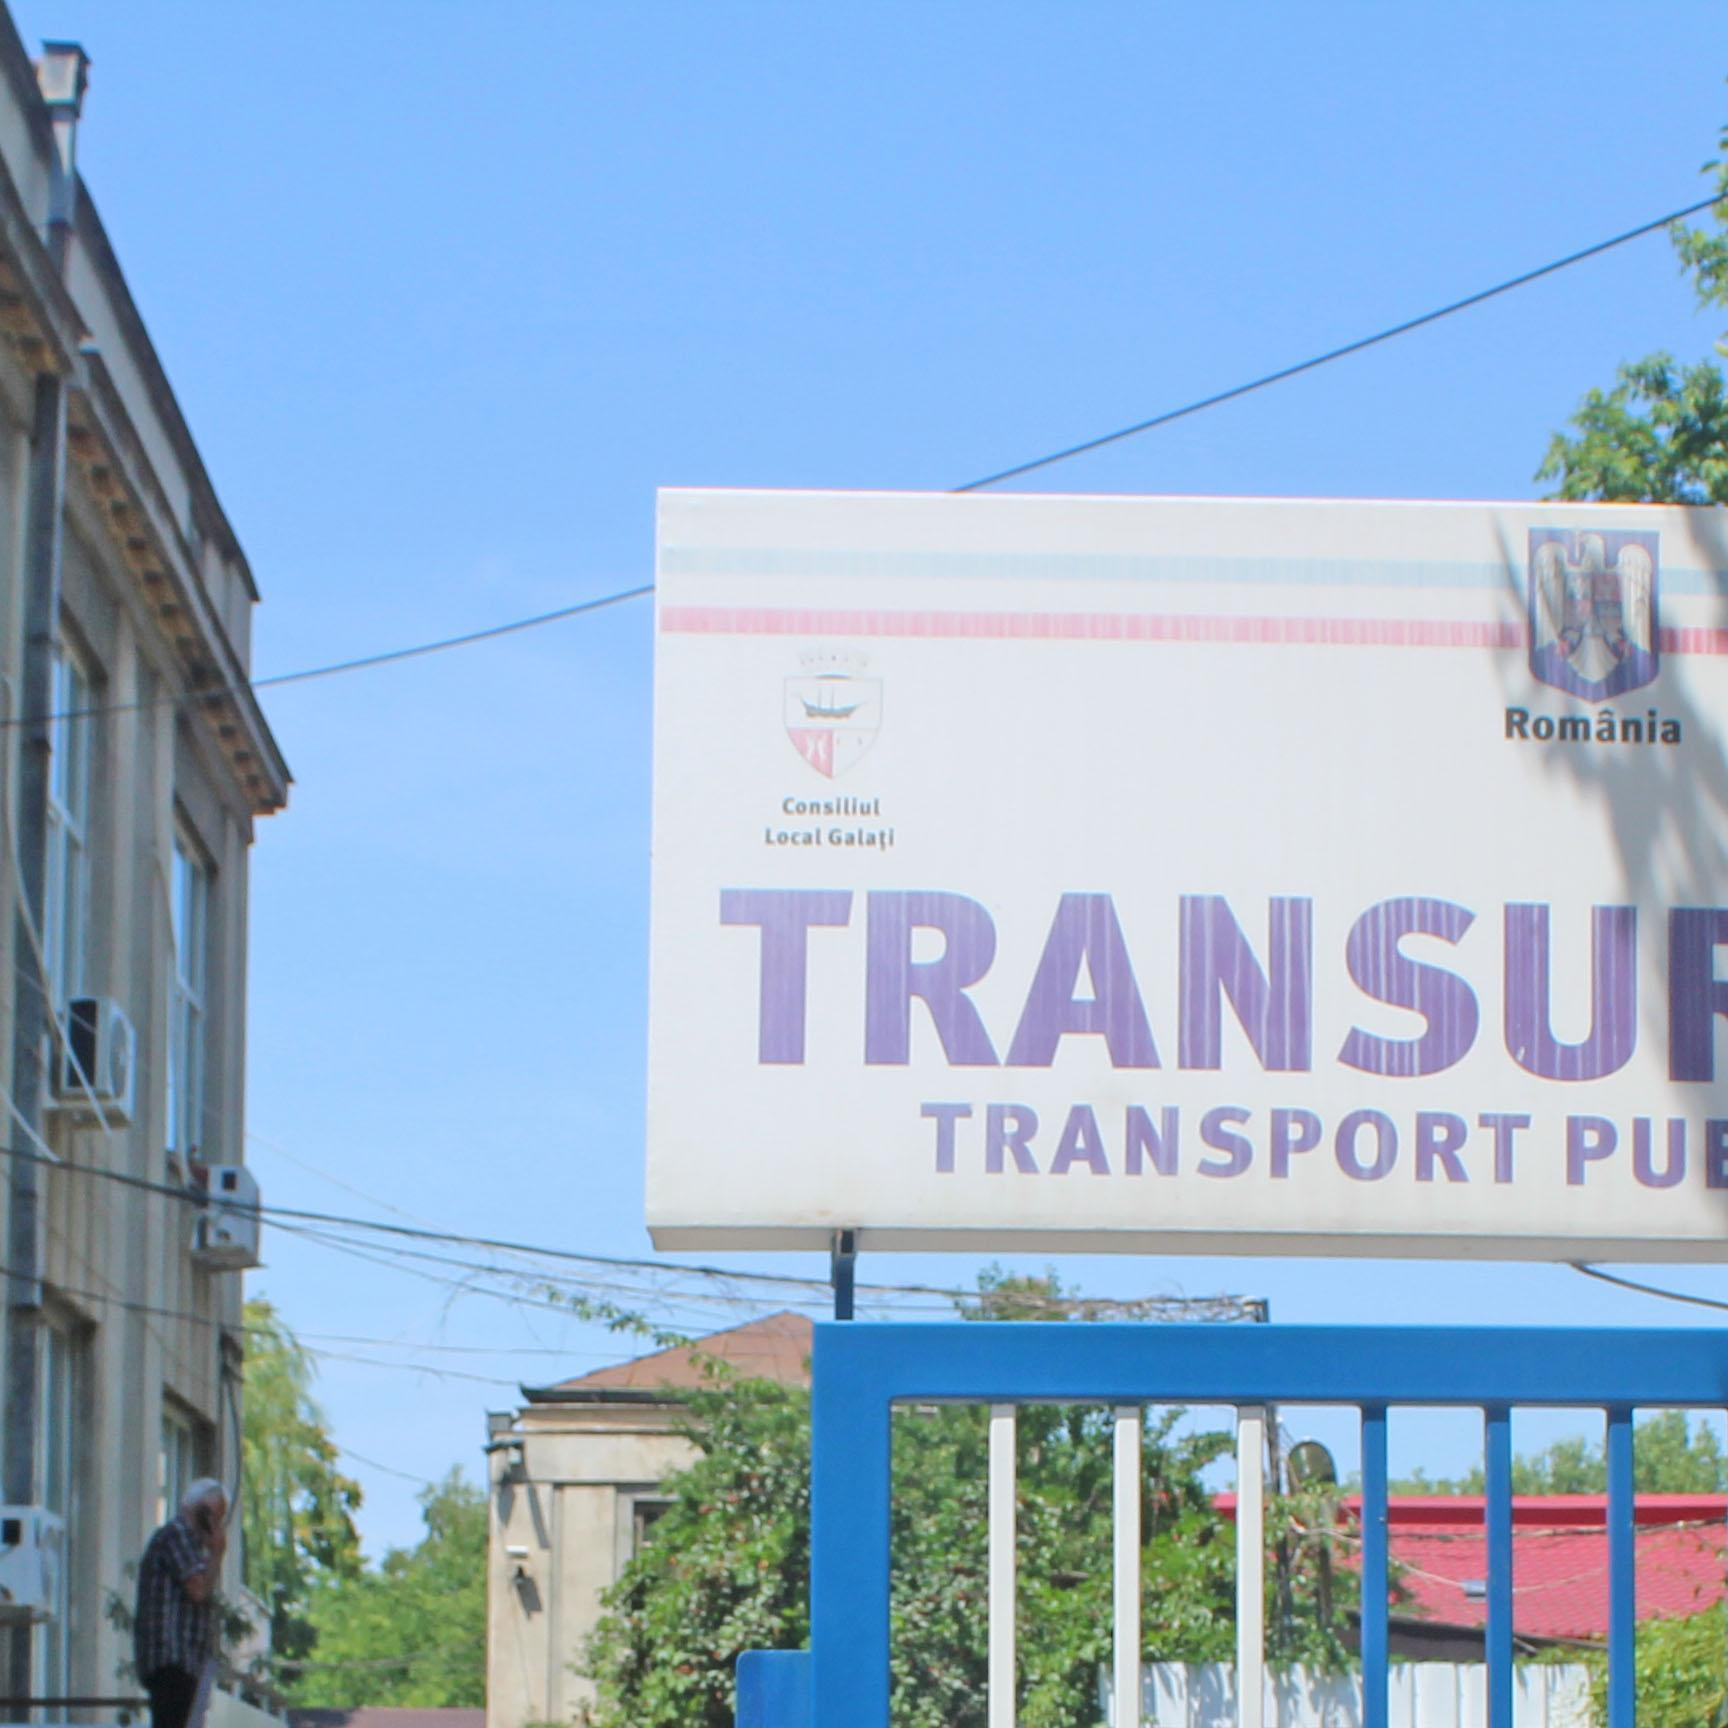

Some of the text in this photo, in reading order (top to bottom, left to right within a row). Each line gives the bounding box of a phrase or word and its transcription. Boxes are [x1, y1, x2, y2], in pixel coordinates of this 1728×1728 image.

[1505, 707, 1682, 745] România
[781, 796, 881, 817] Consiliul
[765, 826, 822, 846] Local
[920, 1101, 1531, 1184] TRANSPORT
